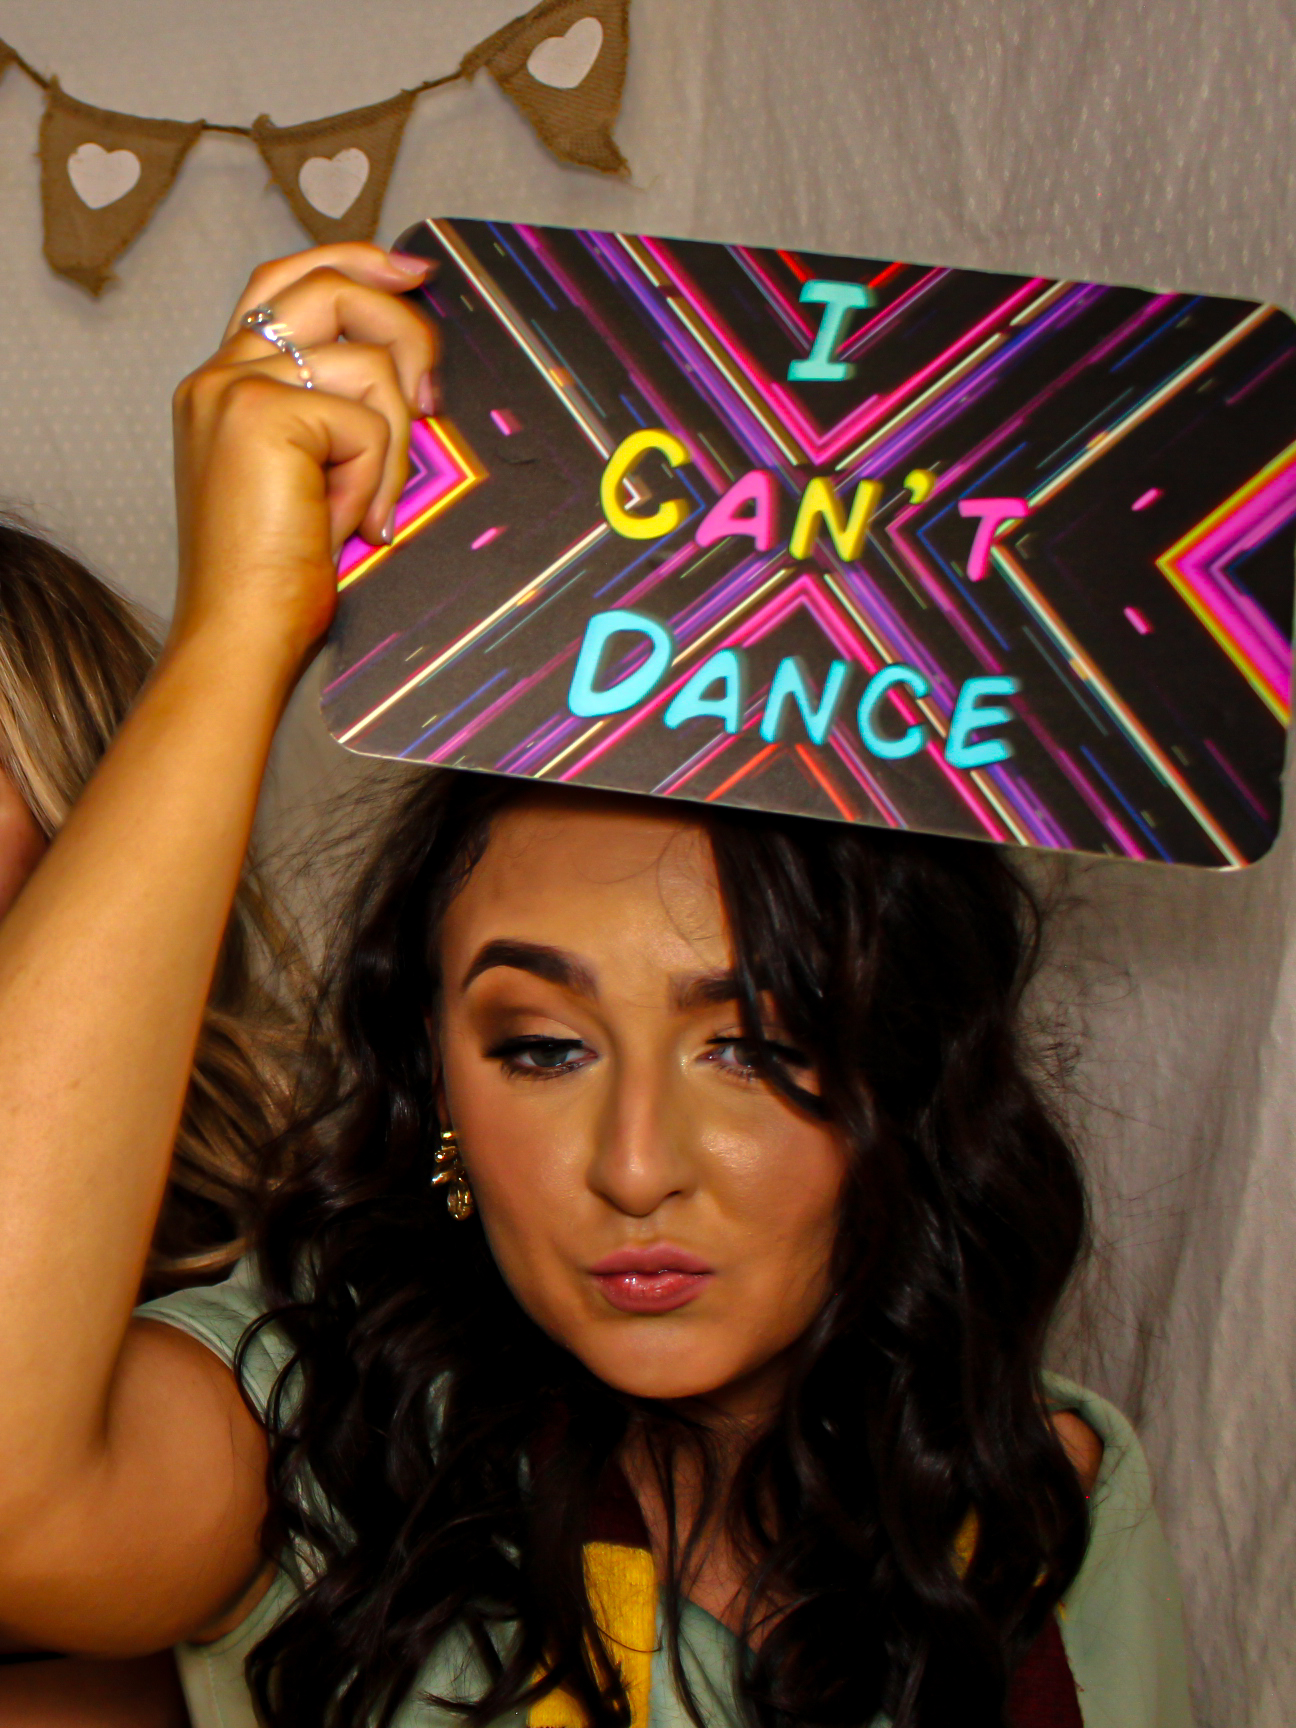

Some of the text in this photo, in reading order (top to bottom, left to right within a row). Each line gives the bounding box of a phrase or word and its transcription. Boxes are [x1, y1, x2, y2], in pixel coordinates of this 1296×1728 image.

[787, 279, 875, 381] I
[599, 428, 1030, 581] CAN'T
[568, 609, 1019, 769] DANCE
